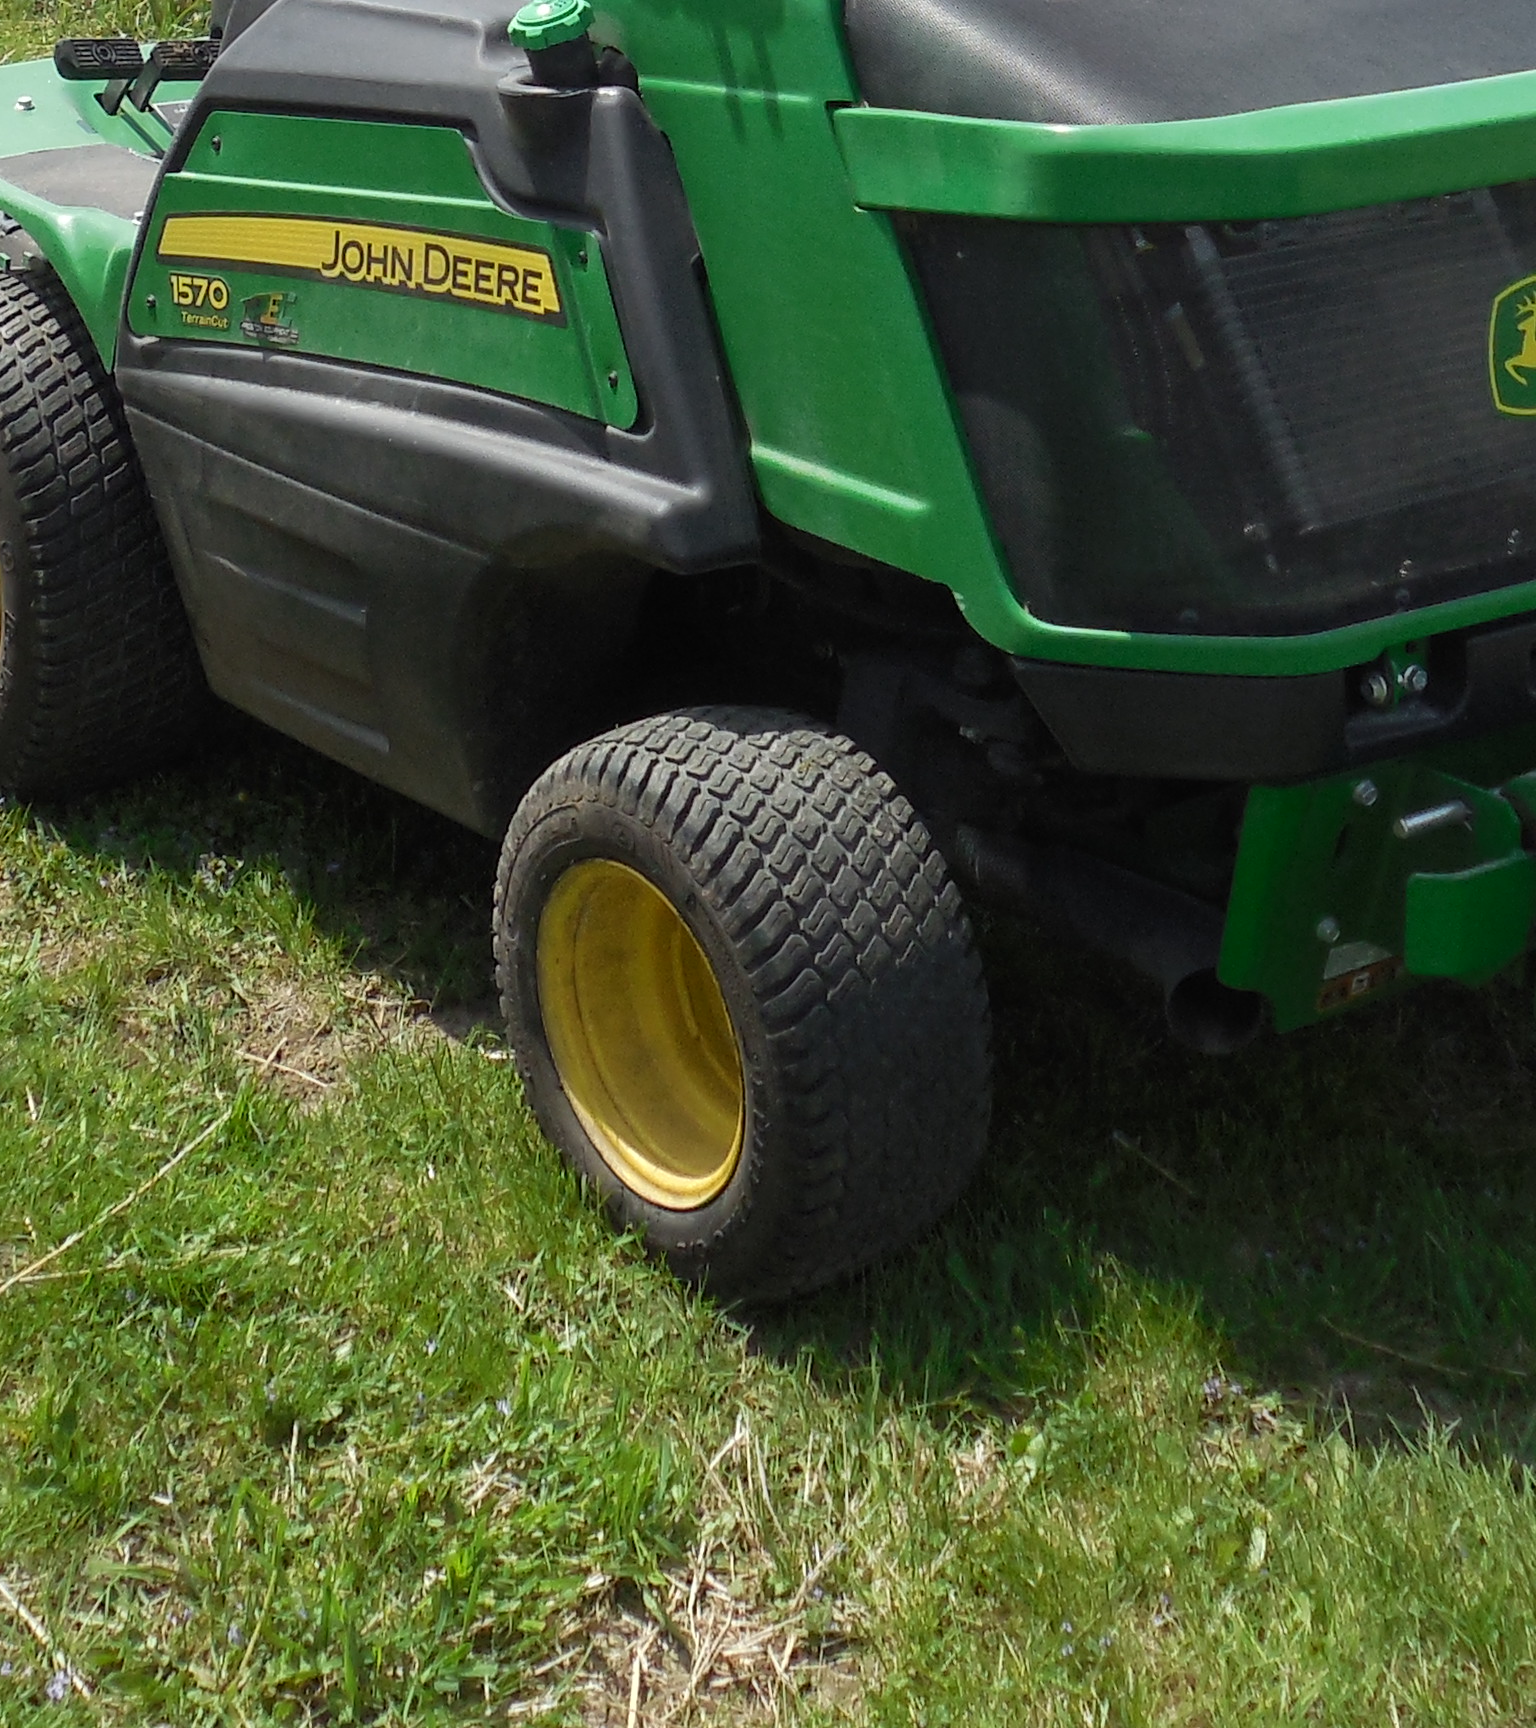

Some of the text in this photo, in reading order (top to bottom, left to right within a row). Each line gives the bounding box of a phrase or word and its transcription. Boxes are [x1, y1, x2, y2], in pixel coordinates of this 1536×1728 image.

[321, 230, 544, 307] JOHN DEERE
[170, 274, 229, 311] 1570
[181, 311, 230, 329] TerrainCut
